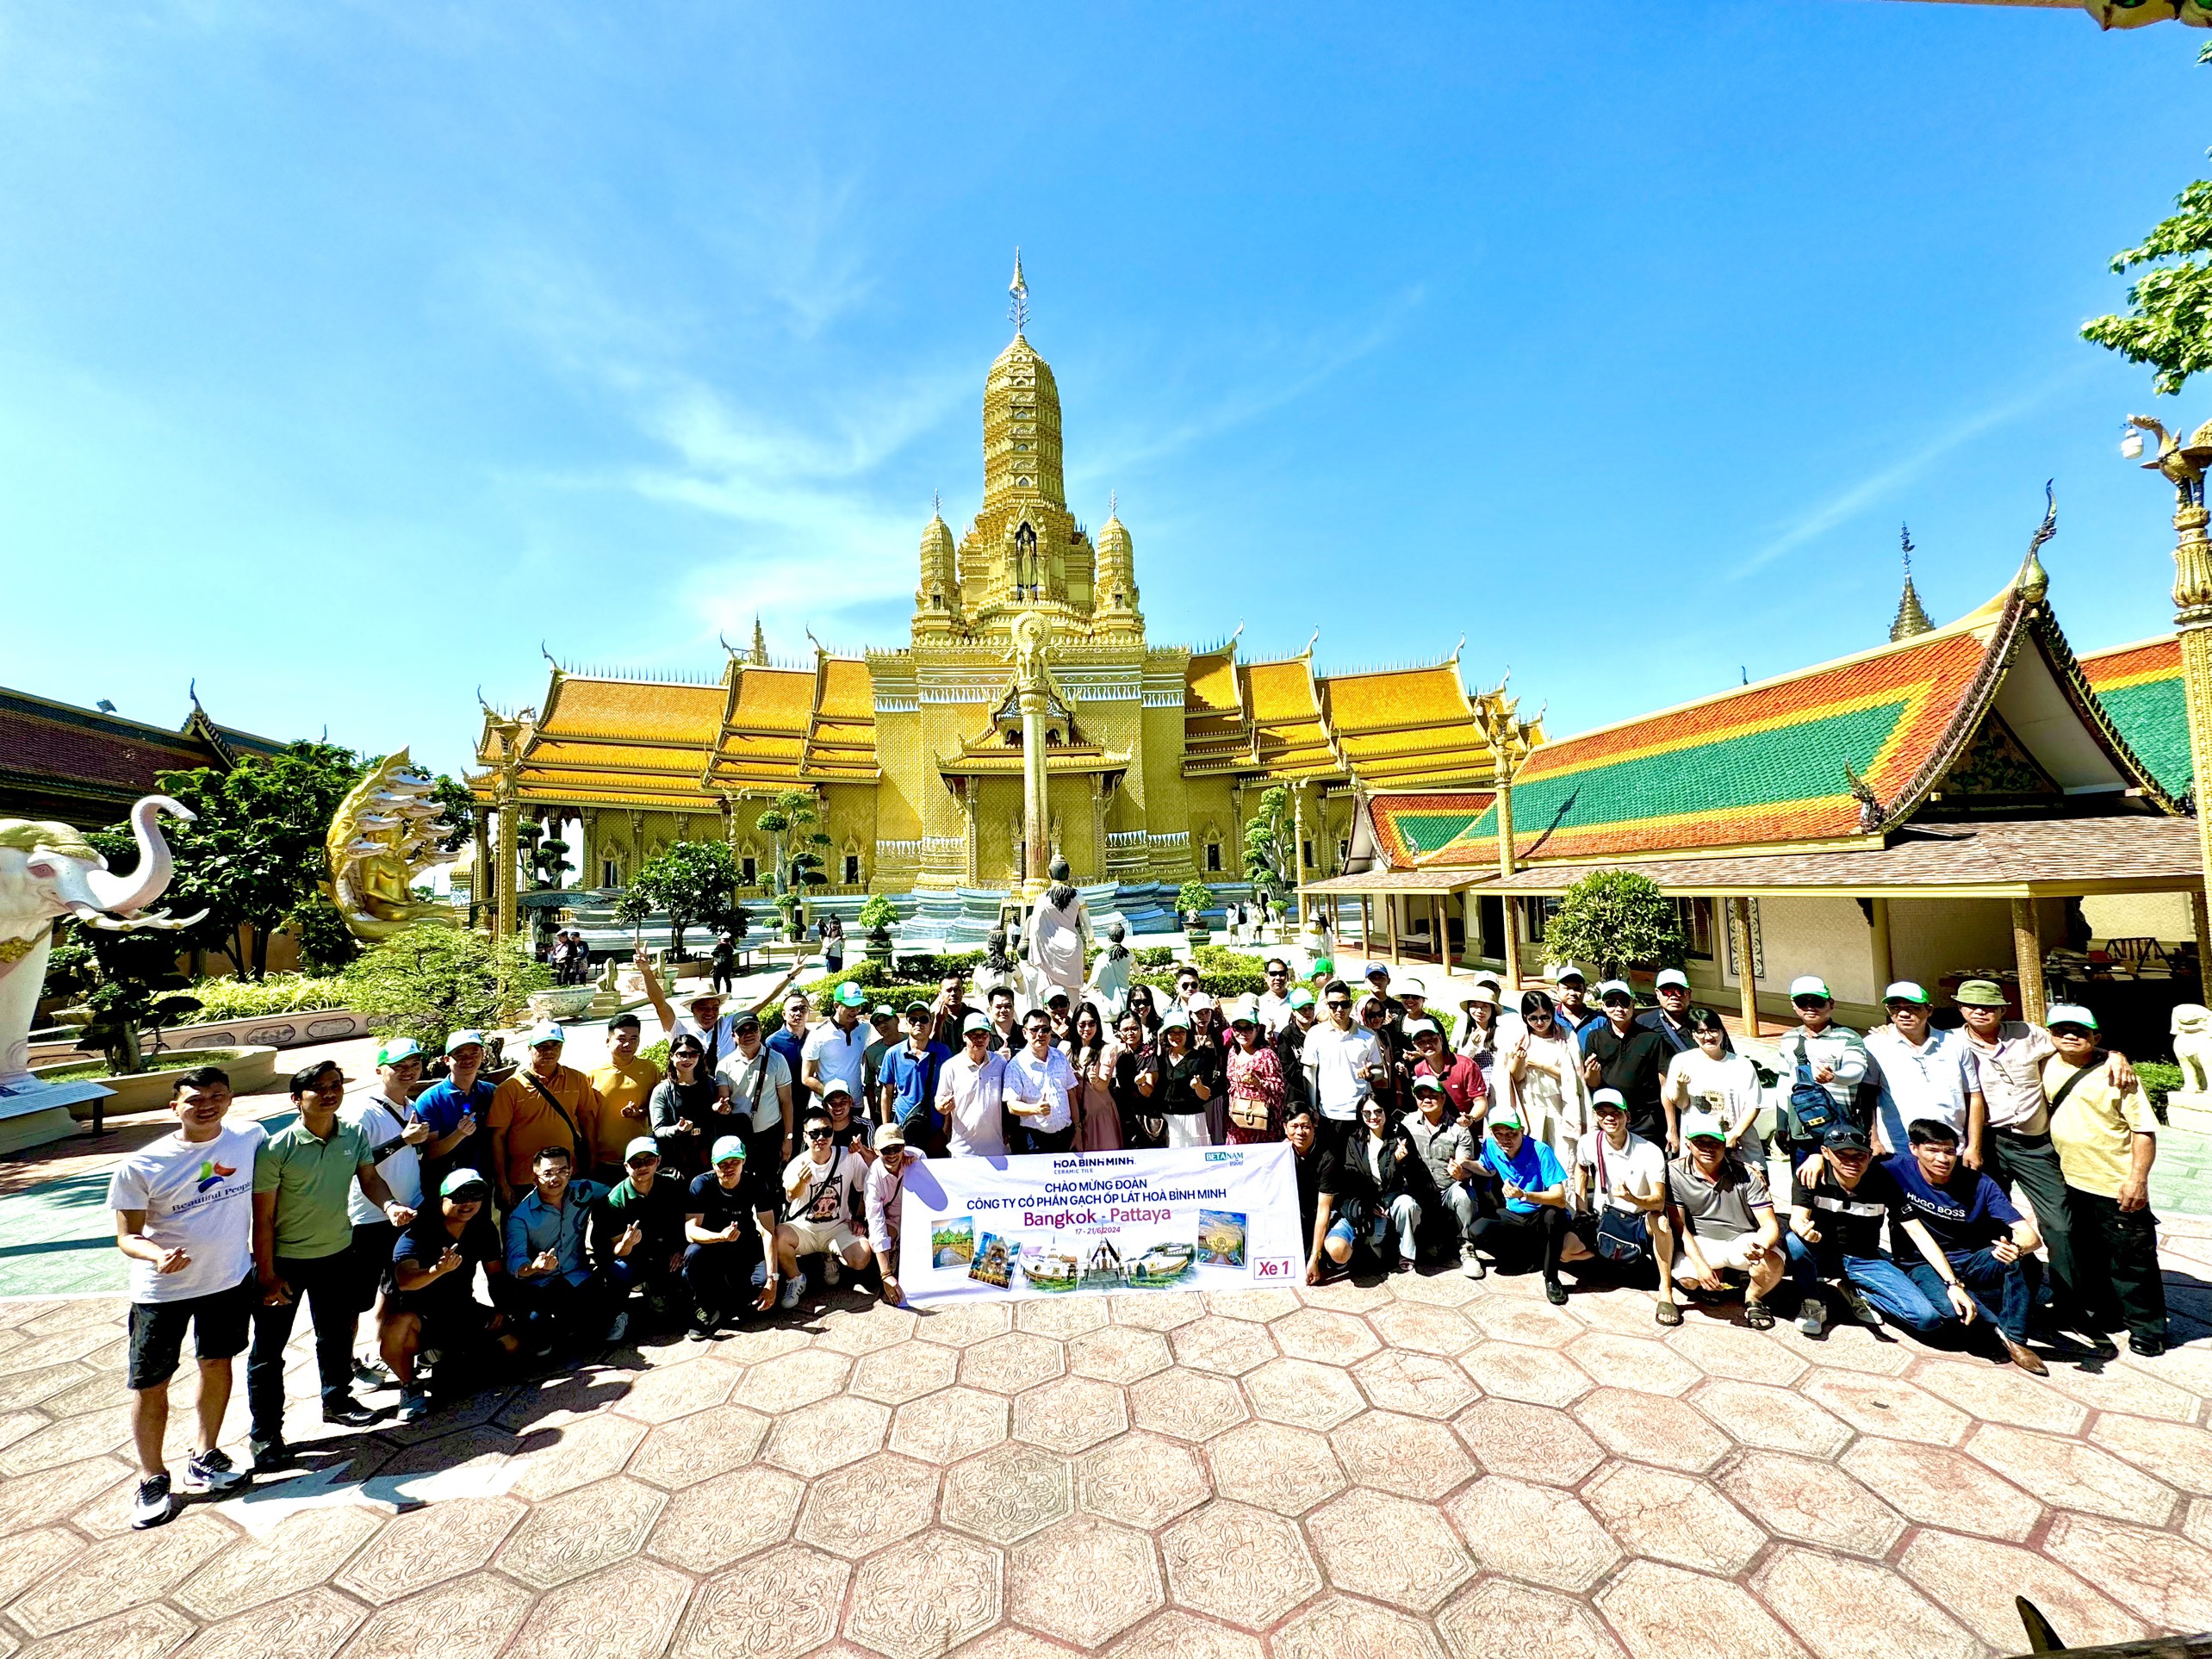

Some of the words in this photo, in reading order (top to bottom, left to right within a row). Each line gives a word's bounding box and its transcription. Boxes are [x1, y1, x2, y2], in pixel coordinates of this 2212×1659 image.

[1106, 1156, 1135, 1166] MINH
[1045, 1179, 1078, 1193] CHÀO
[1078, 1178, 1113, 1191] MỪNG
[1115, 1177, 1147, 1190] ĐOÀN
[172, 1190, 221, 1211] Beautiful
[966, 1197, 1000, 1209] CÔNG
[1002, 1198, 1016, 1208] TY
[1069, 1194, 1102, 1208] GẠCH
[1103, 1190, 1119, 1203] ỐP
[1122, 1190, 1140, 1202] LÁT
[1142, 1189, 1167, 1202] HOÀ
[1169, 1188, 1196, 1201] BÌNH
[1197, 1189, 1227, 1200] MINH
[1906, 1192, 1936, 1209] HUGO
[1937, 1206, 1966, 1217] BOSS
[1024, 1209, 1097, 1229] Bangkok
[1110, 1208, 1171, 1224] Pattaya
[1087, 1227, 1121, 1235] 21/6/2024
[1258, 1261, 1277, 1276] Xe
[1282, 1260, 1289, 1275] 1
